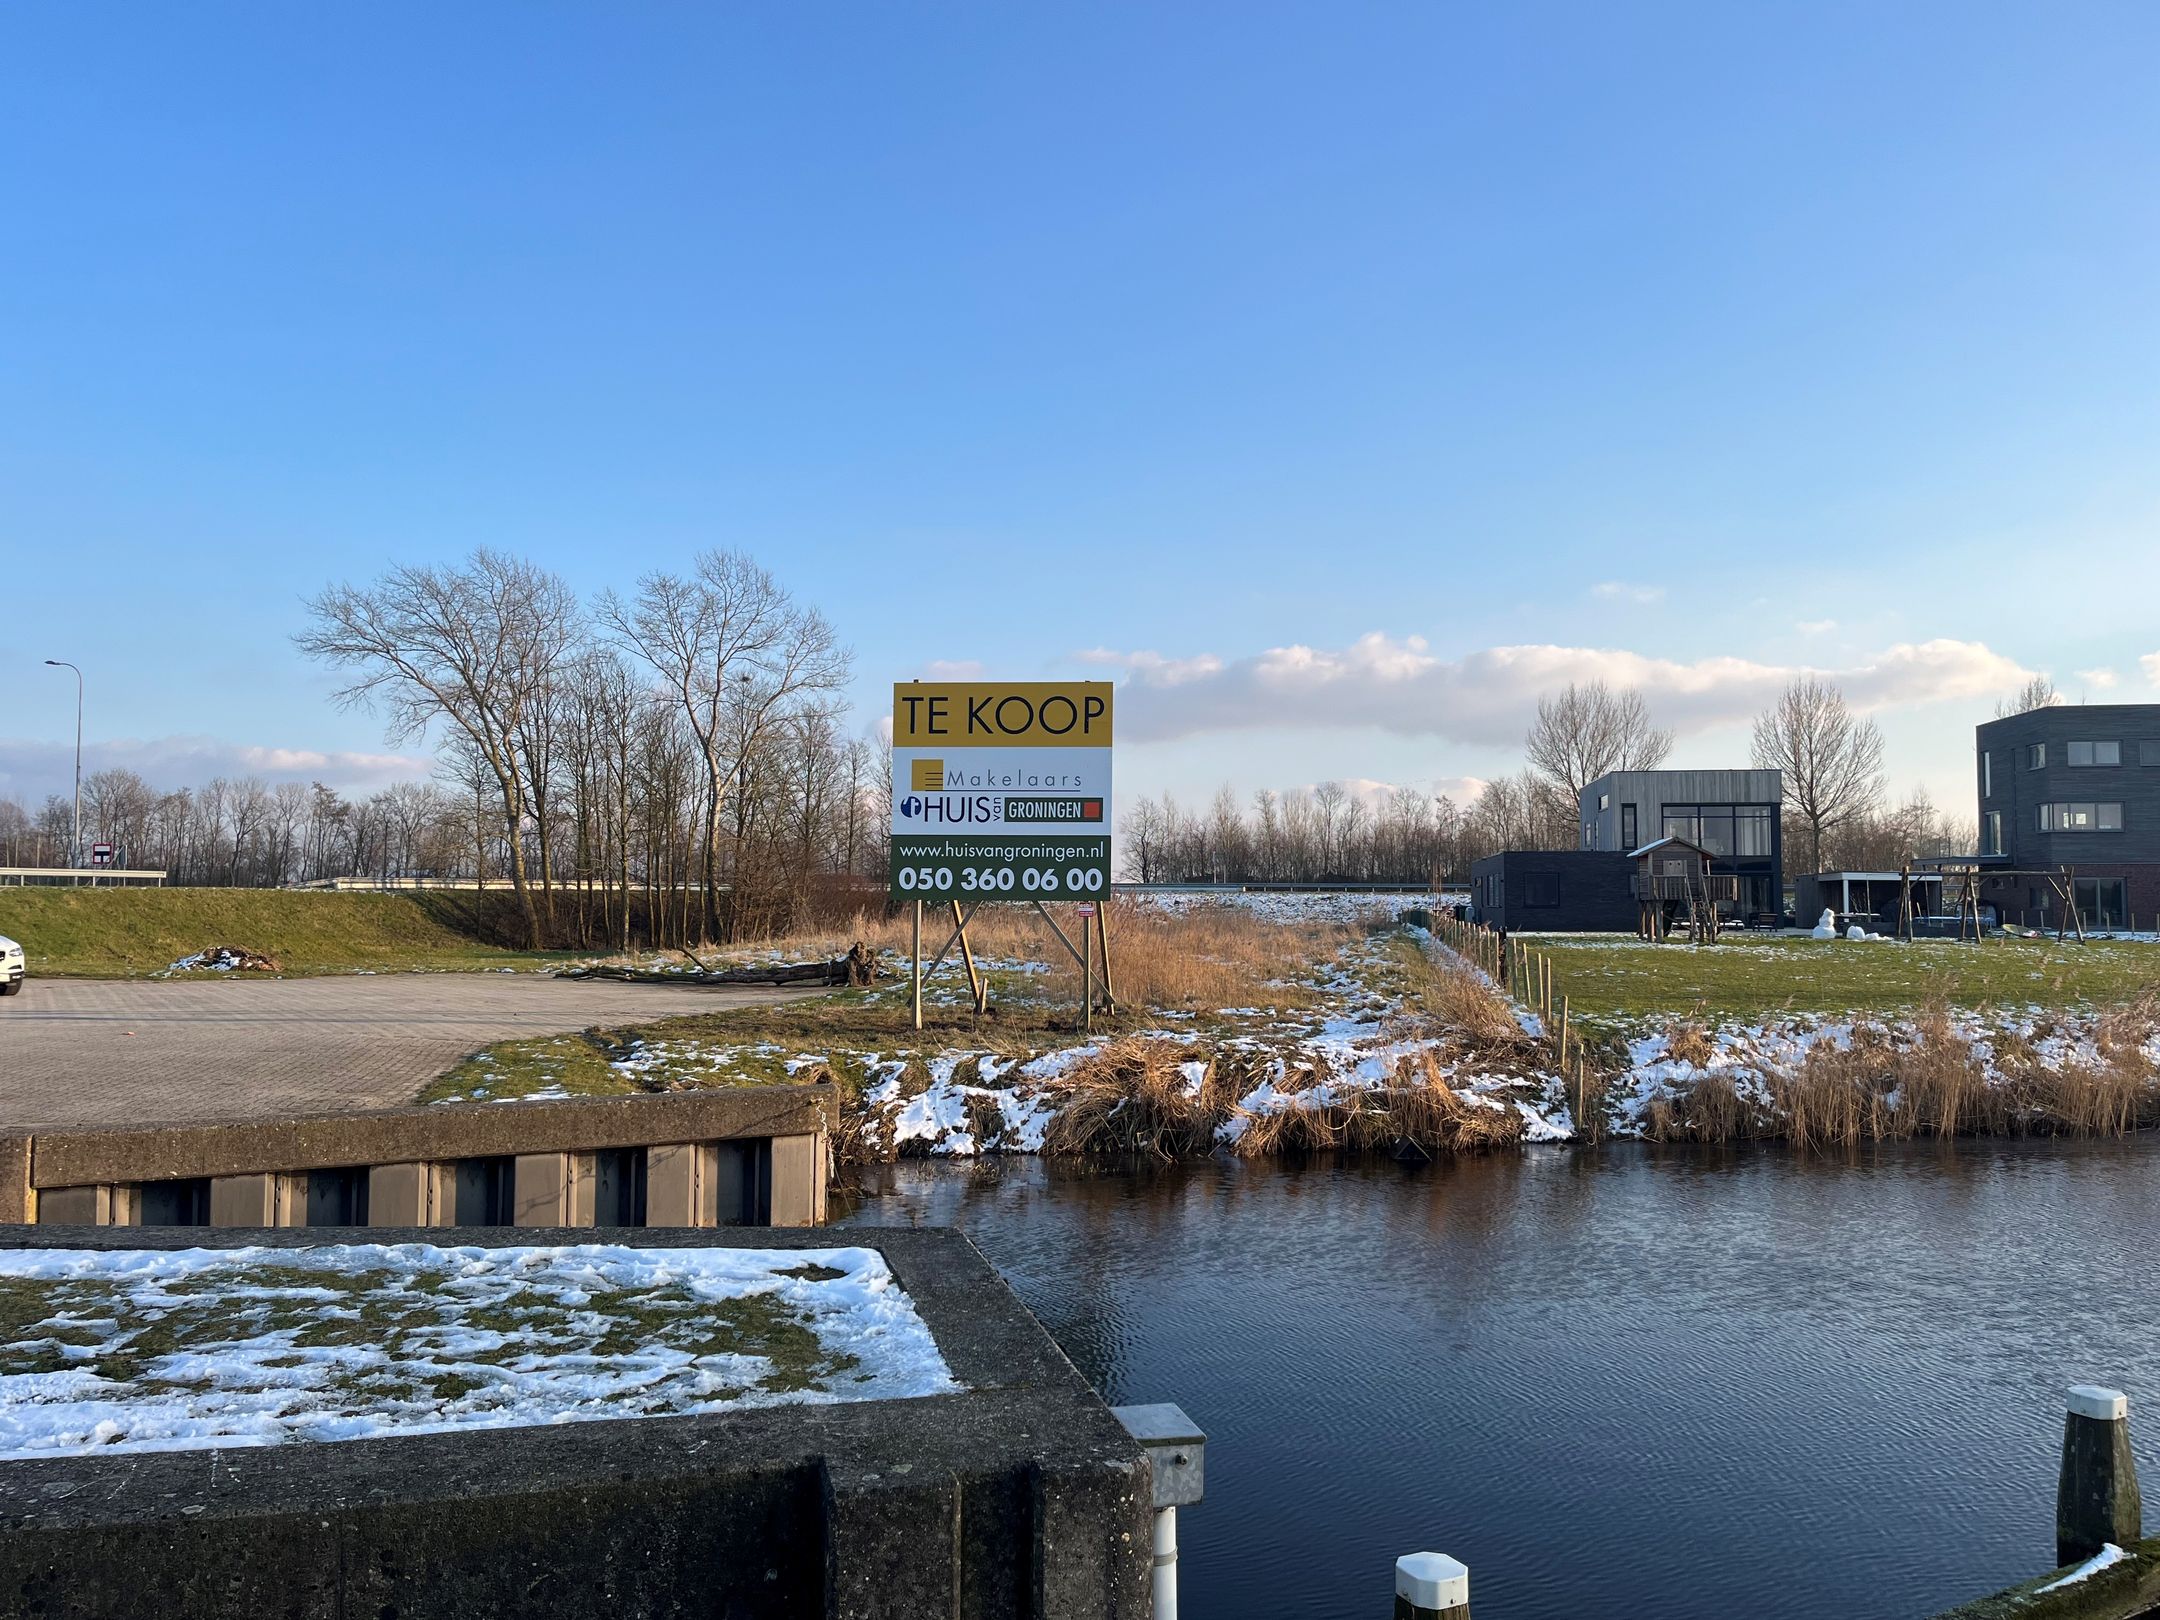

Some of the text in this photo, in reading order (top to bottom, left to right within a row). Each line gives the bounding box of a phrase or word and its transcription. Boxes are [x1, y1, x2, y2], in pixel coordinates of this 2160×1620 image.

[902, 696, 1105, 734] TE KOOP
[947, 769, 1082, 787] Makelaars
[924, 796, 991, 823] HUIS
[993, 797, 1002, 822] van
[1008, 801, 1081, 819] GRONINGEN
[899, 840, 1104, 862] www.huisvangroningen.nl
[899, 867, 1103, 891] 050 360 06 00
